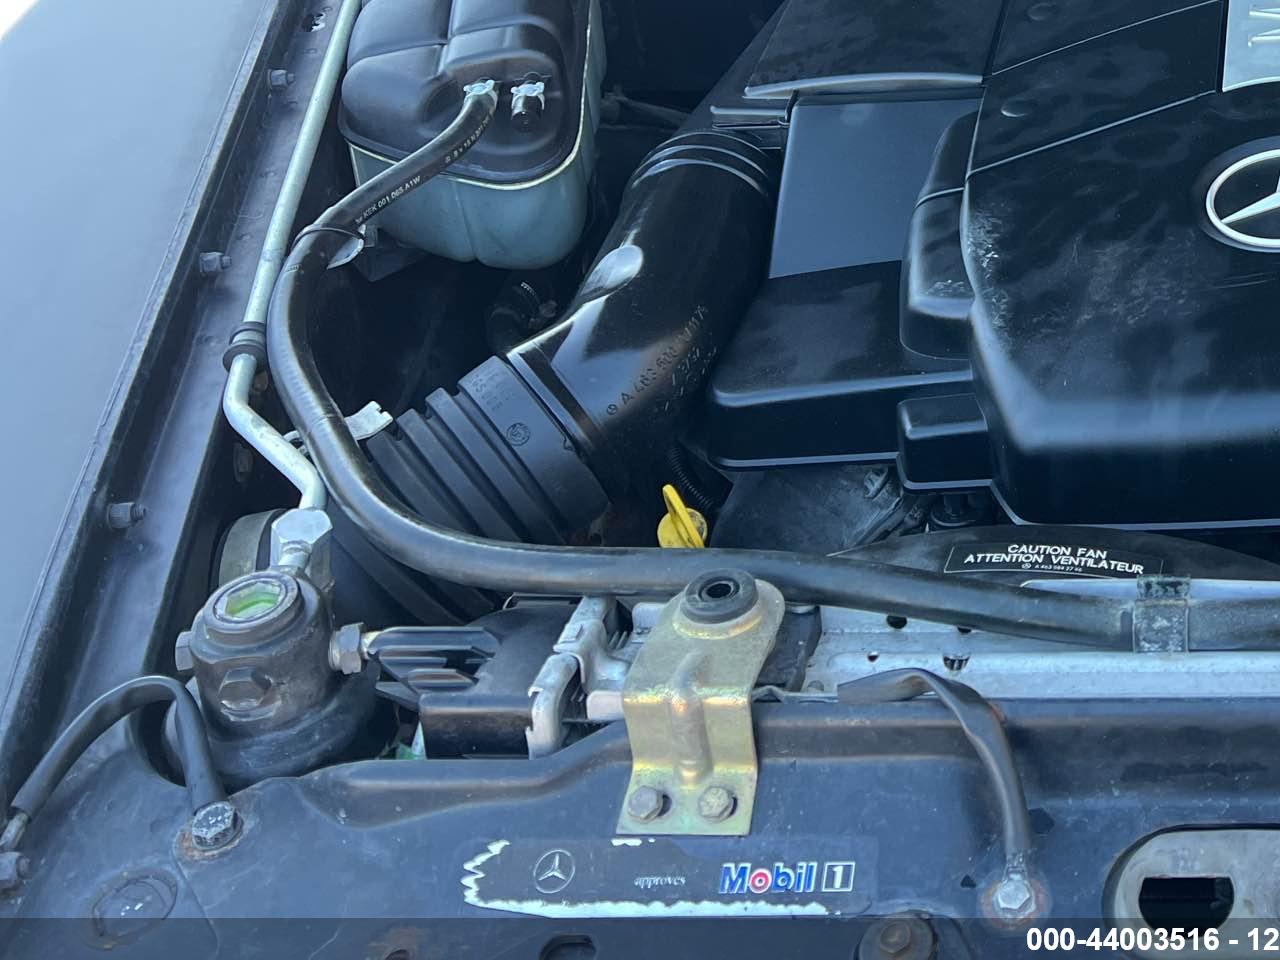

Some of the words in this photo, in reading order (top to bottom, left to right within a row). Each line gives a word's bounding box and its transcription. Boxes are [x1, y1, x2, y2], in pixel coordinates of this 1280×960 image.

[1007, 544, 1072, 556] CAUTION
[1077, 547, 1108, 559] FAN
[964, 553, 1045, 564] ATTENTION
[1051, 555, 1145, 575] VENTILATEUR
[719, 862, 819, 894] Mobil
